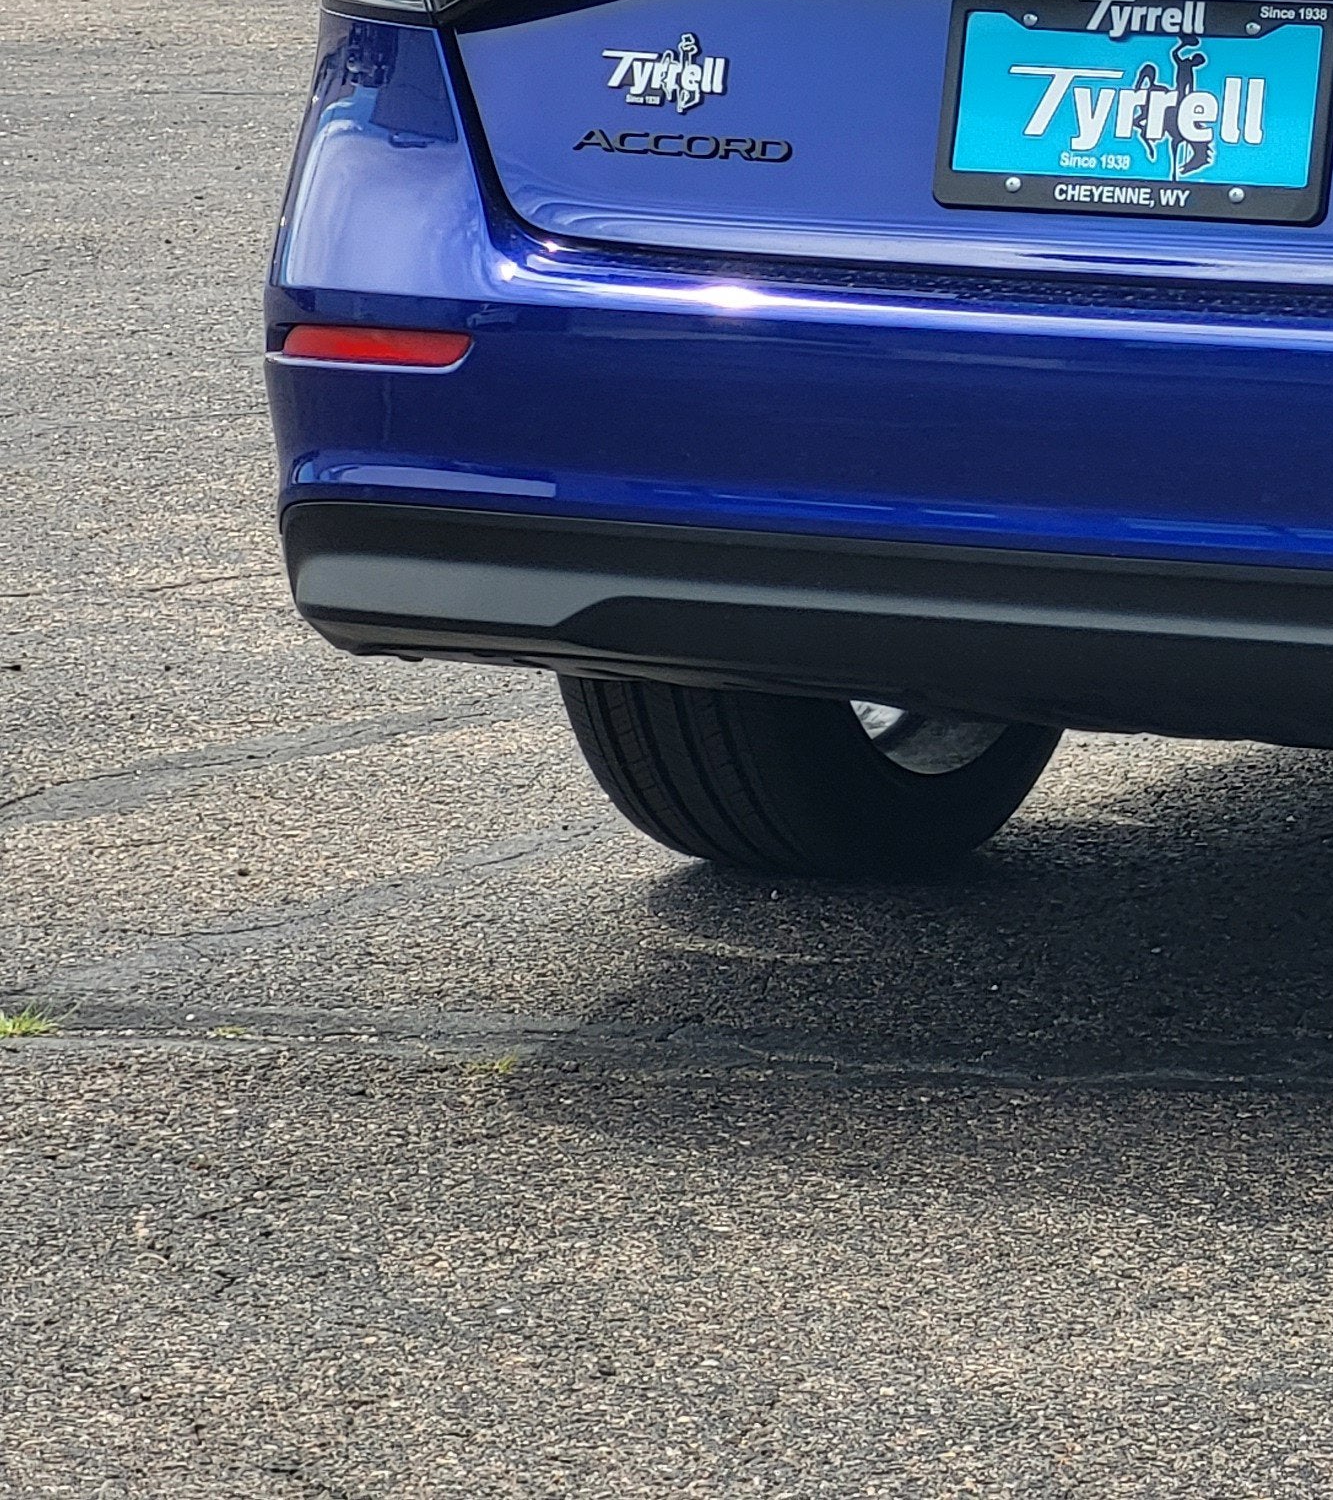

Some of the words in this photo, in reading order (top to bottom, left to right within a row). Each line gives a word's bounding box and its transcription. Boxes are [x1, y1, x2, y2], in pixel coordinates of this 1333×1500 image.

[1260, 5, 1296, 20] Since
[1298, 7, 1328, 21] 1938
[602, 49, 726, 95] Tyrrell
[1008, 64, 1267, 151] Tyrrell
[573, 129, 793, 162] ACCORD
[1059, 151, 1097, 169] Since
[1100, 153, 1131, 171] 1938
[1053, 183, 1155, 208] CHEYENNE,
[1159, 188, 1191, 207] WY
